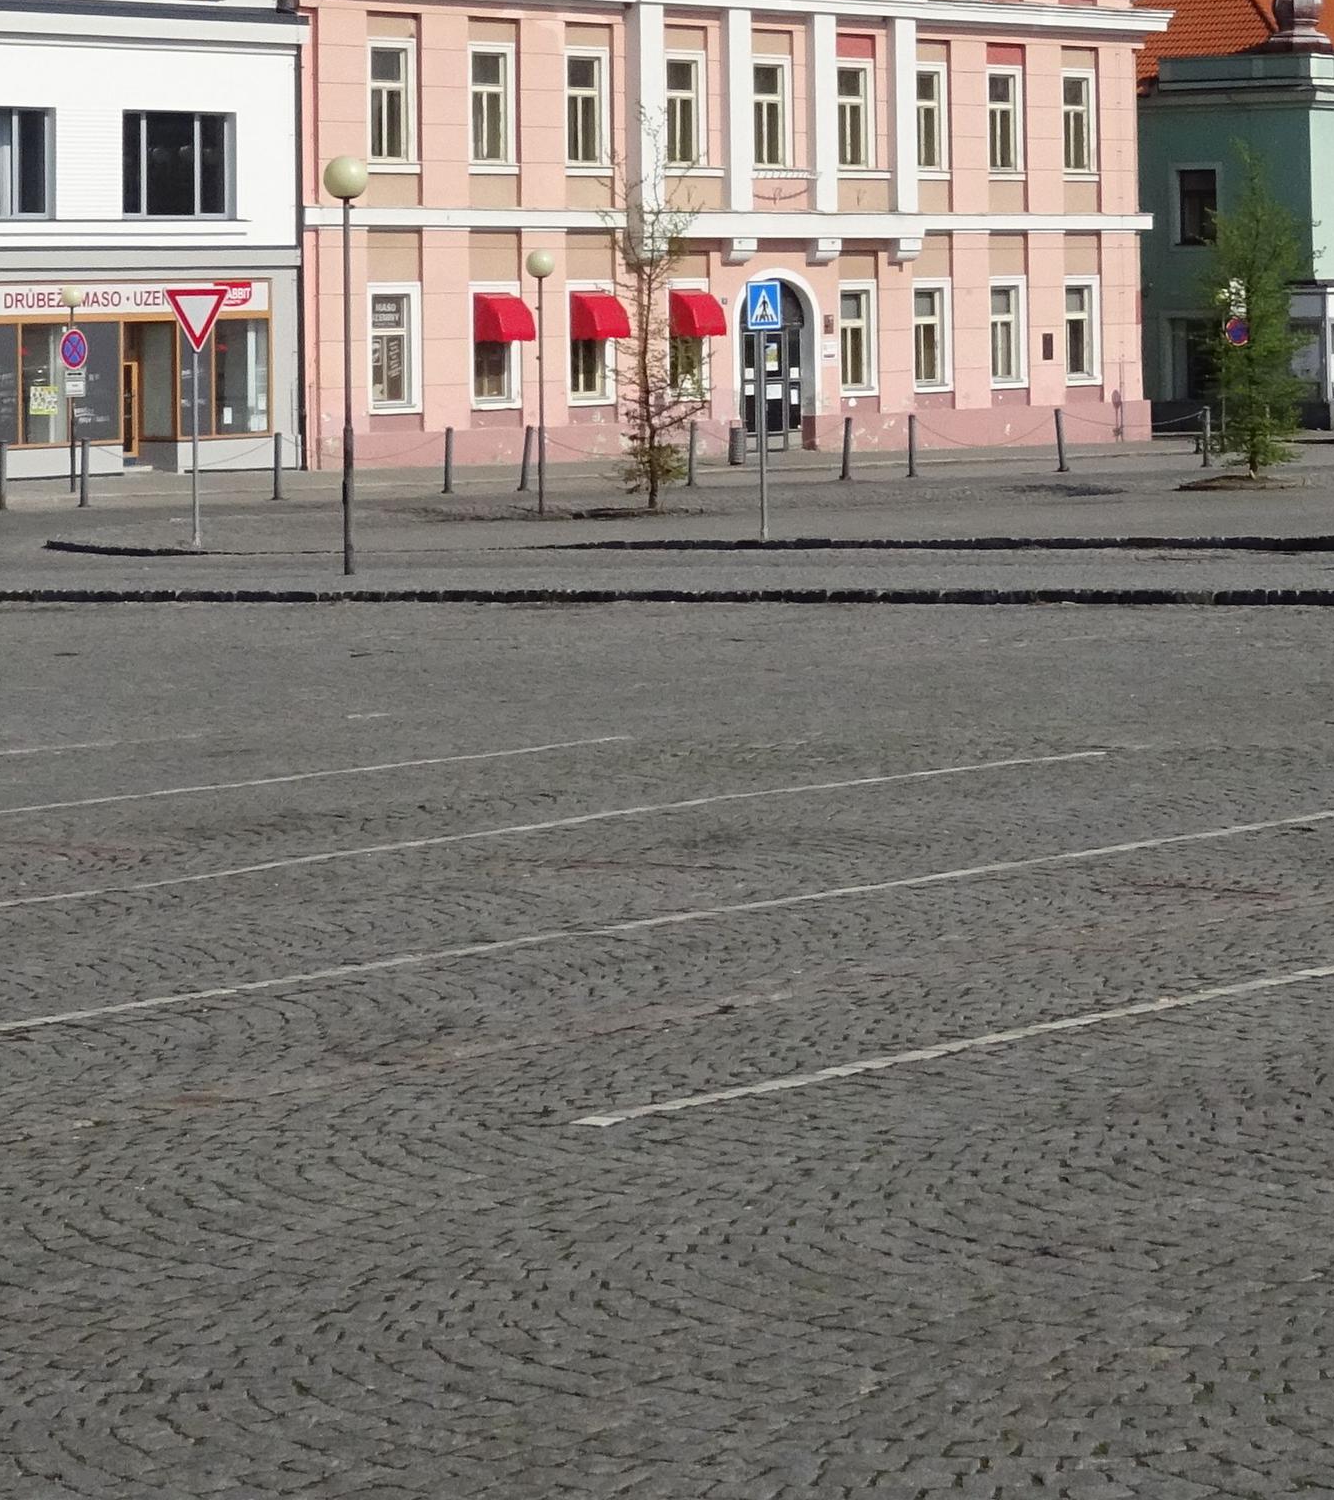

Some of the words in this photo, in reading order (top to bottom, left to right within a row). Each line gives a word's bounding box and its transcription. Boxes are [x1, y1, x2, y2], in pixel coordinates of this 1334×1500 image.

[4, 287, 66, 309] DRŮBEŽ
[80, 290, 122, 308] MASO
[133, 290, 171, 307] UZEN
[227, 287, 251, 300] ABBIT
